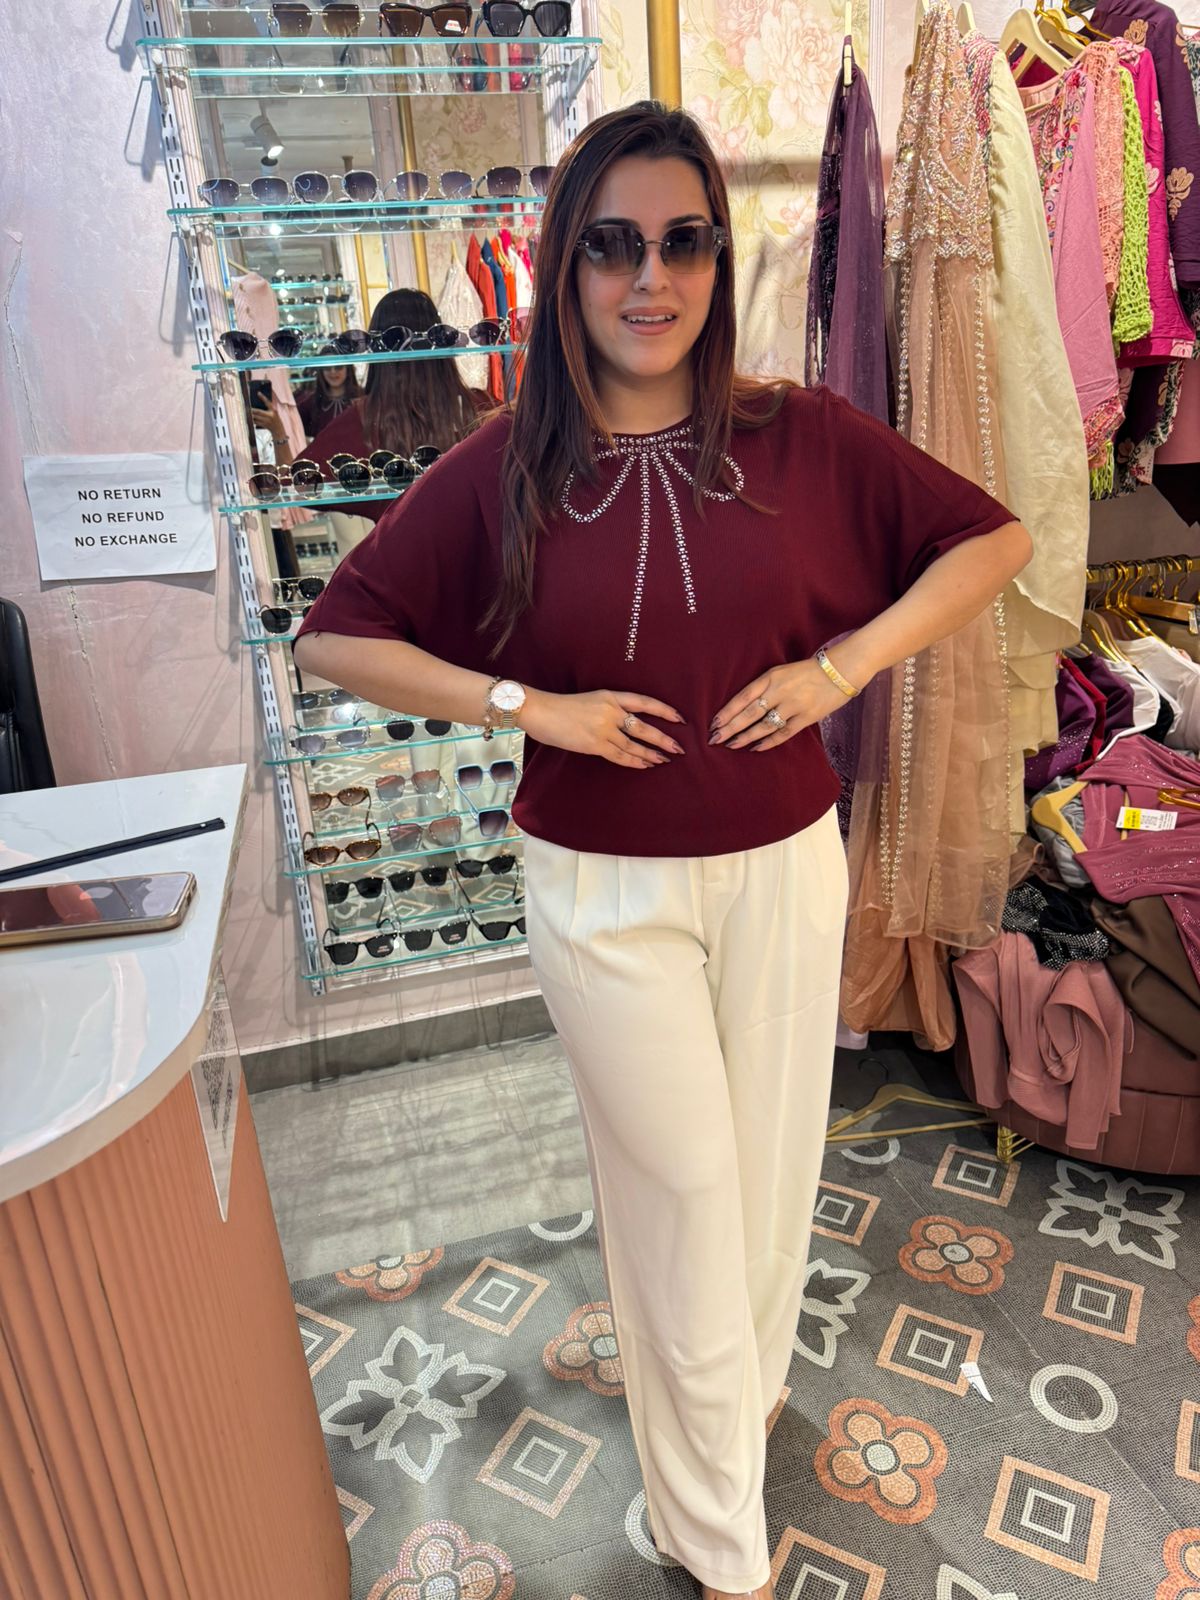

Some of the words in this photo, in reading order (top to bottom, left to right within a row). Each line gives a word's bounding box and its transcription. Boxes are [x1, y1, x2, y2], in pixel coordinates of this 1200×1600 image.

[78, 490, 99, 501] NO
[103, 488, 162, 500] RETURN
[82, 513, 103, 524] NO
[107, 511, 165, 523] REFUND
[75, 536, 96, 547] NO
[100, 533, 178, 546] EXCHANGE
